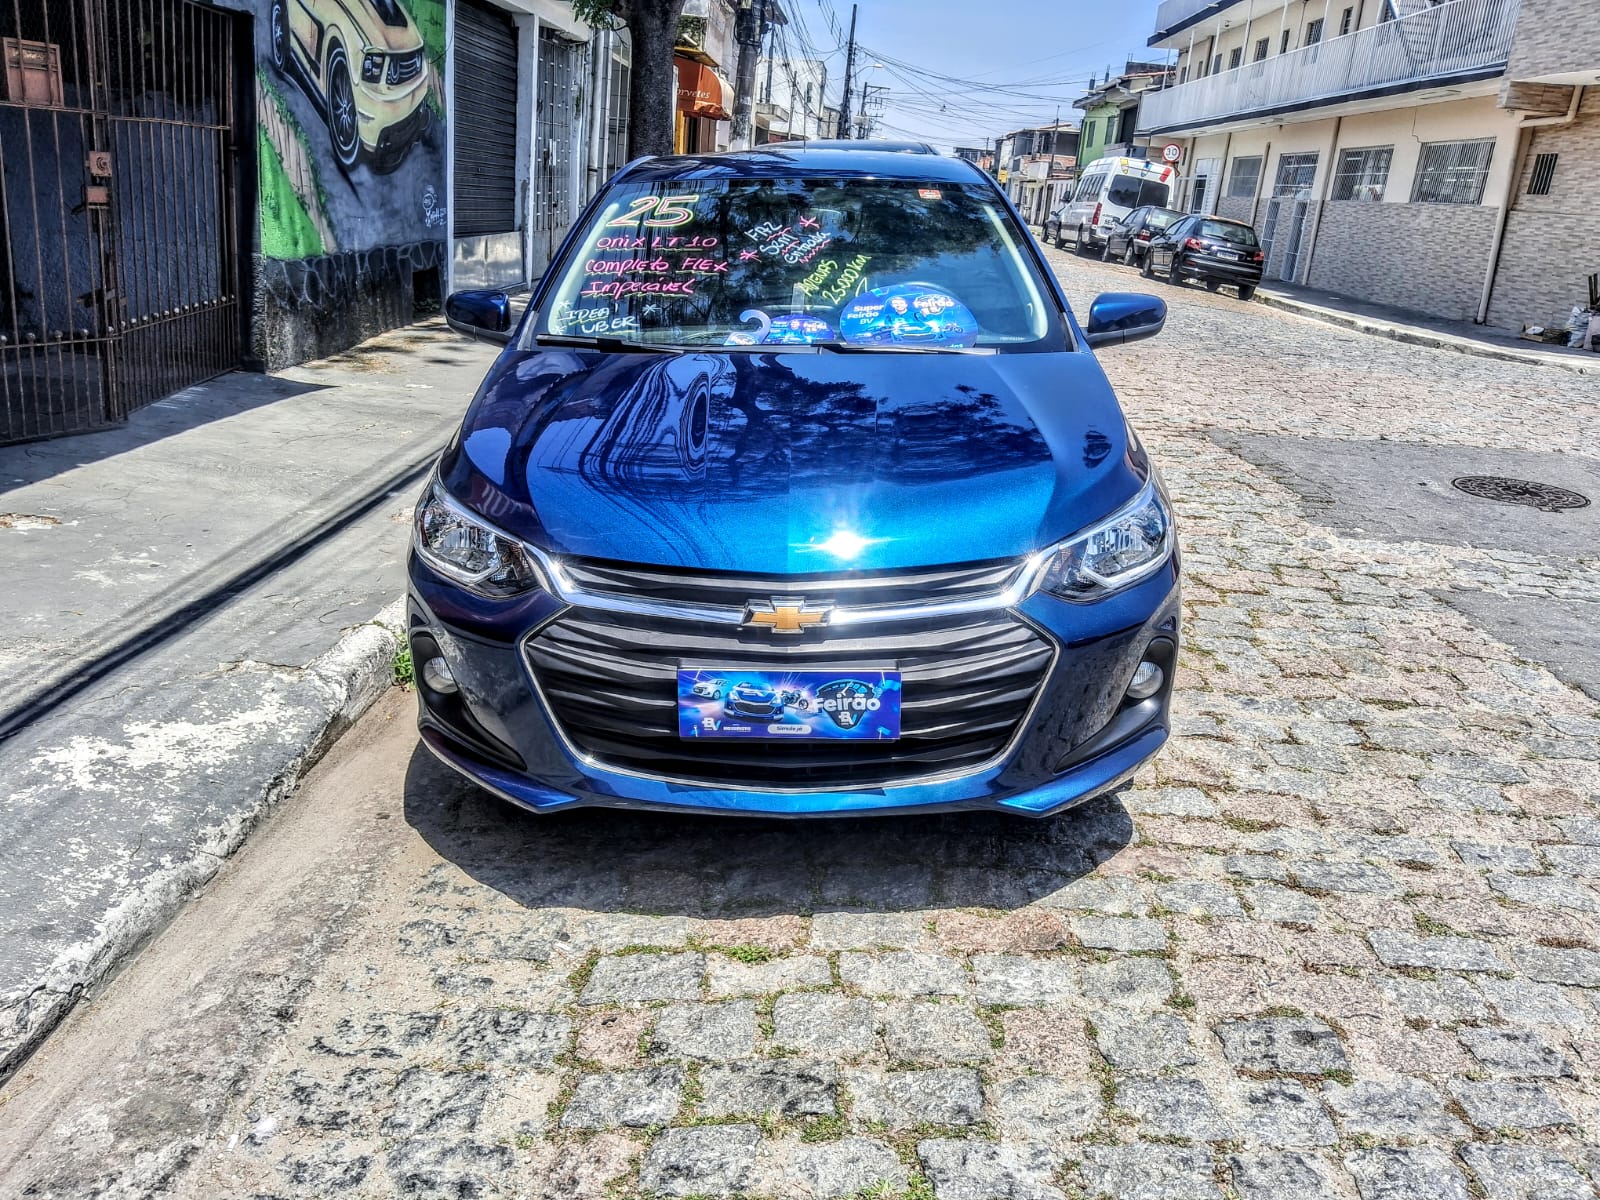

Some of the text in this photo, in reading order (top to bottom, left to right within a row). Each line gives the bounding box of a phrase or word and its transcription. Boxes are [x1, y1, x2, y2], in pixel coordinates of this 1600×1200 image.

[677, 88, 711, 99] orvetes
[1165, 147, 1178, 156] 30
[606, 195, 699, 227] 25
[744, 221, 783, 241] FAZ
[652, 236, 687, 248] LT
[854, 304, 885, 313] Super
[581, 315, 641, 334] UBER
[813, 693, 881, 713] Feirão
